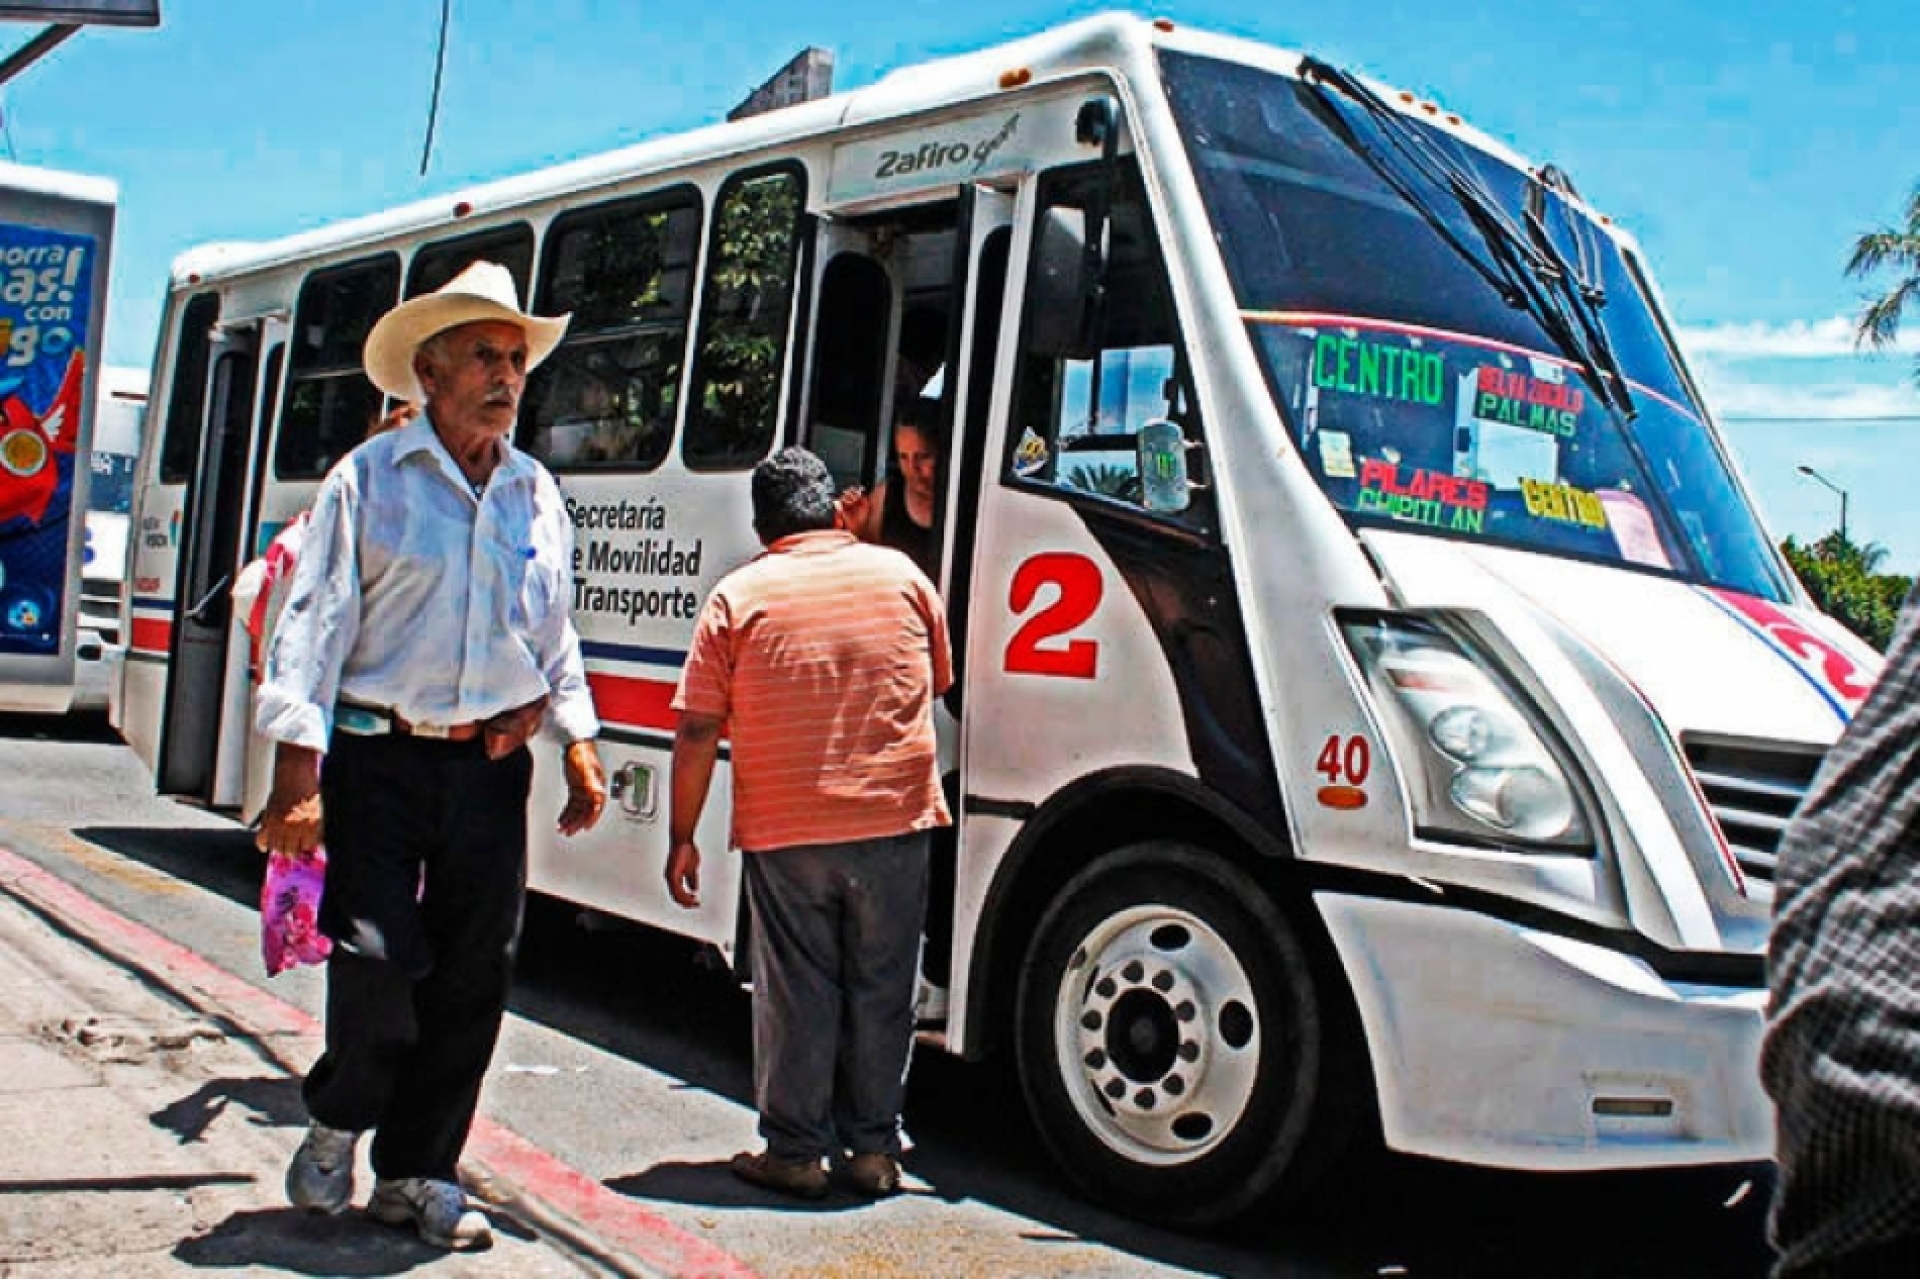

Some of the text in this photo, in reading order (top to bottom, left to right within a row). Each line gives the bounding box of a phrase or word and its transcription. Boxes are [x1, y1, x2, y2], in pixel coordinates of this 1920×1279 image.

[875, 141, 969, 178] Zafiro
[0, 245, 65, 266] orra
[24, 307, 71, 320] con
[1315, 334, 1444, 405] CENTRO
[1479, 392, 1577, 438] PALMAS
[1361, 457, 1488, 511] PILARES
[565, 495, 666, 530] Secretaría
[587, 537, 702, 576] Movilidad
[573, 576, 698, 626] Transporte
[1004, 551, 1103, 679] 2
[1316, 734, 1372, 786] 40
